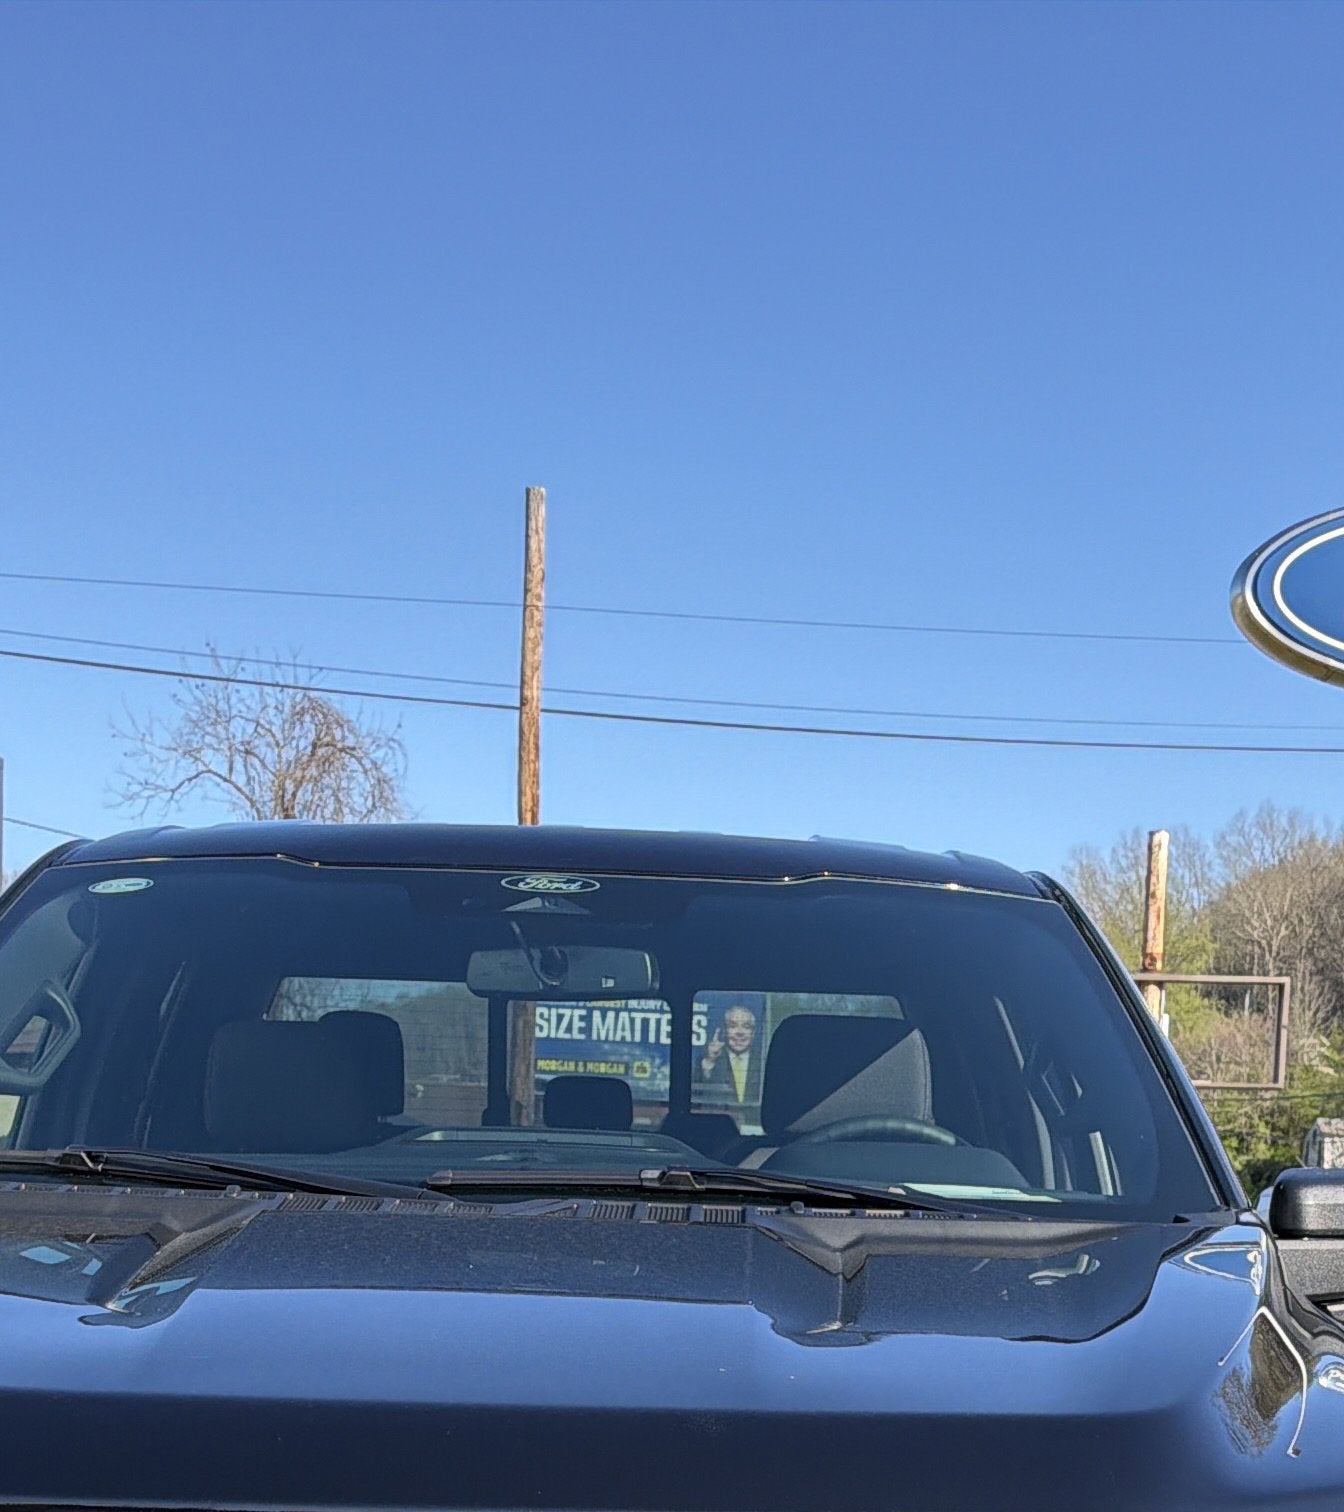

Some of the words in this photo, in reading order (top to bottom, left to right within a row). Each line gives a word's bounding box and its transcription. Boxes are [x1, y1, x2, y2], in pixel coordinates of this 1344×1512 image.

[518, 877, 583, 889] Ford
[535, 1007, 587, 1040] SIZE
[592, 1010, 708, 1046] MATTES
[536, 1060, 575, 1072] MORGAN
[577, 1061, 584, 1072] &
[586, 1062, 625, 1074] MORGAN
